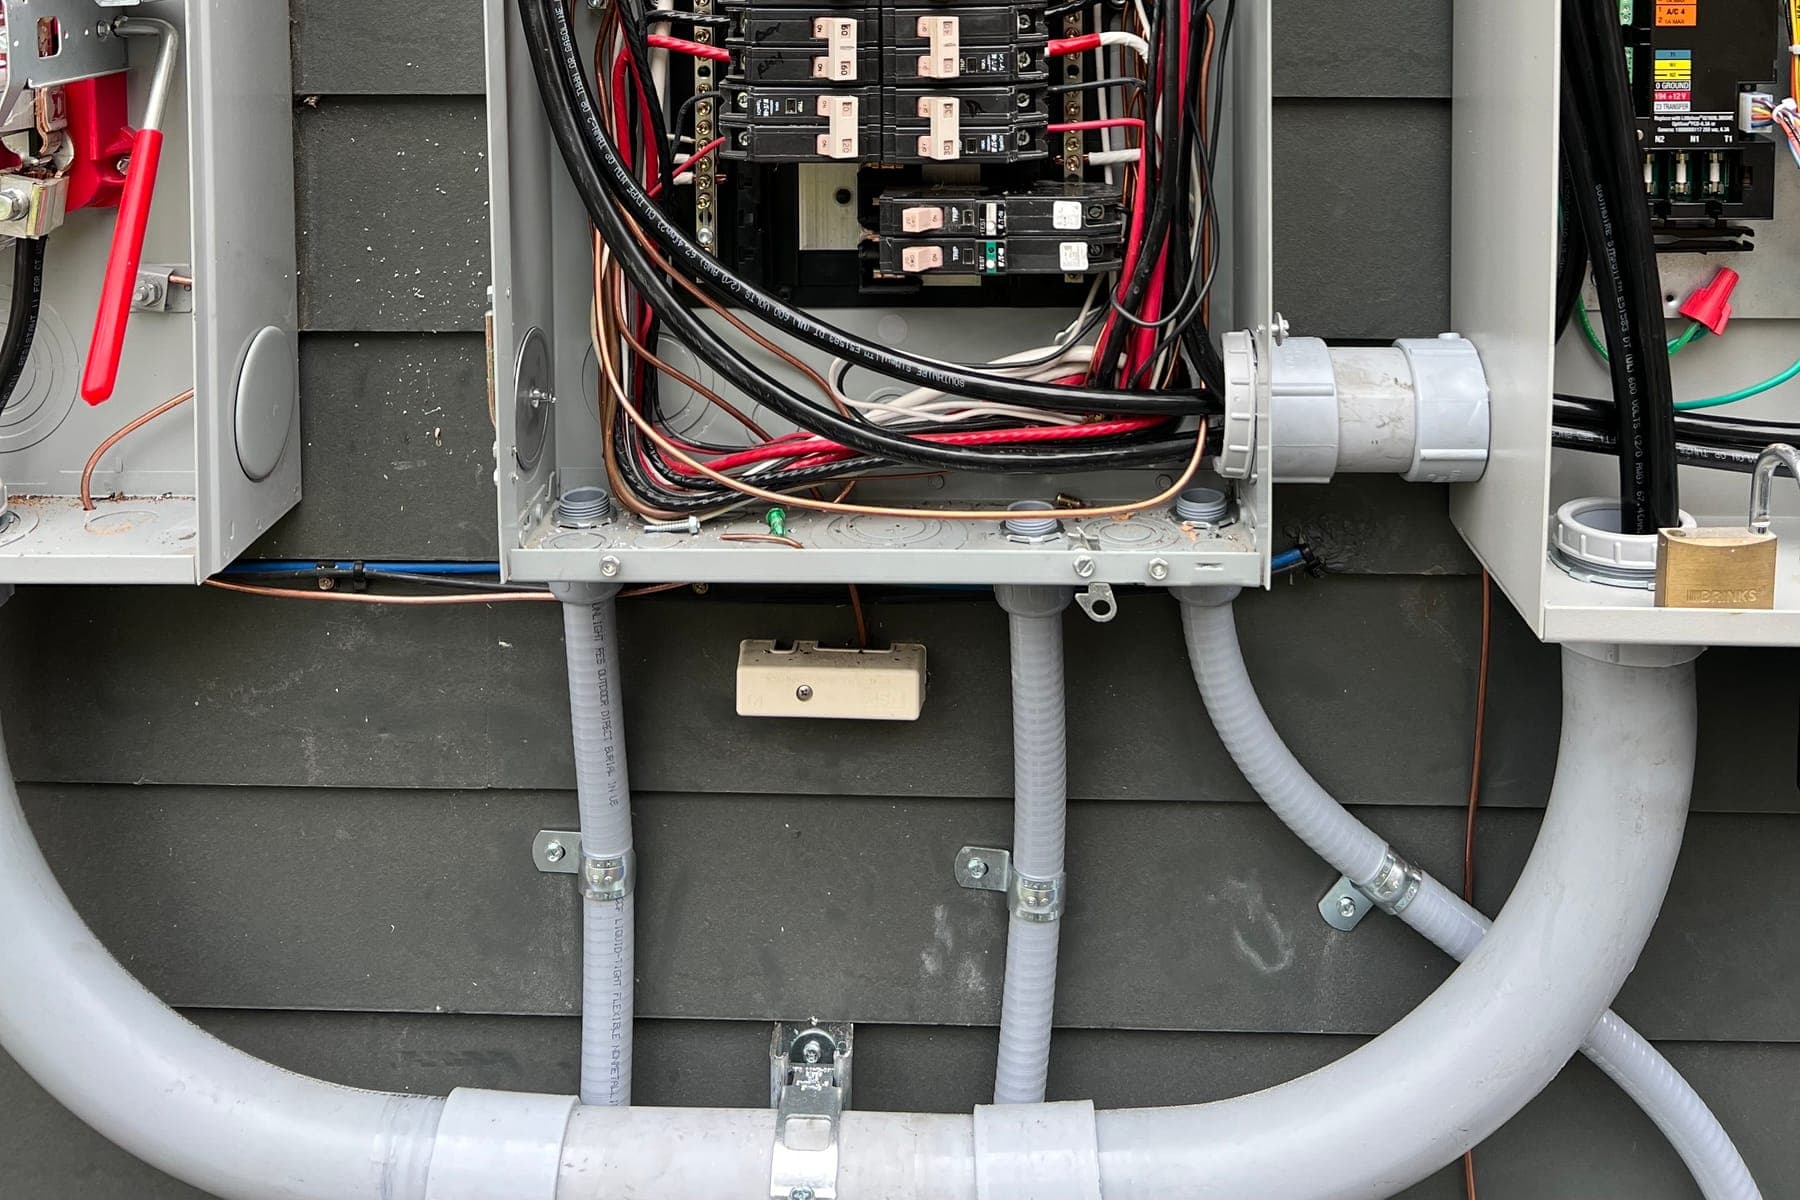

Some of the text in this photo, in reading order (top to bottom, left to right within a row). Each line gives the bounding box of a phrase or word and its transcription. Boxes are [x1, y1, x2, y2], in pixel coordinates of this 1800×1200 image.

[566, 56, 577, 70] OR
[841, 65, 849, 76] 60
[580, 100, 592, 113] OR
[1654, 135, 1665, 143] N2
[1690, 135, 1700, 143] N1
[1724, 135, 1733, 143] T1
[604, 152, 615, 165] OR
[626, 186, 646, 208] TYPE
[33, 275, 41, 293] FOR
[1595, 184, 1612, 236] SOUTHWIRE
[1627, 376, 1637, 395] 600
[773, 308, 790, 322] 600
[829, 334, 861, 354] E51583
[916, 366, 965, 388] SOUTHWIRE
[597, 668, 609, 707] OUTDOOR
[600, 710, 613, 742] DIRECT
[604, 744, 616, 777] BURIAL
[612, 918, 624, 988] LIQUID-TIGHT
[612, 991, 622, 1040] FLEXIBLE
